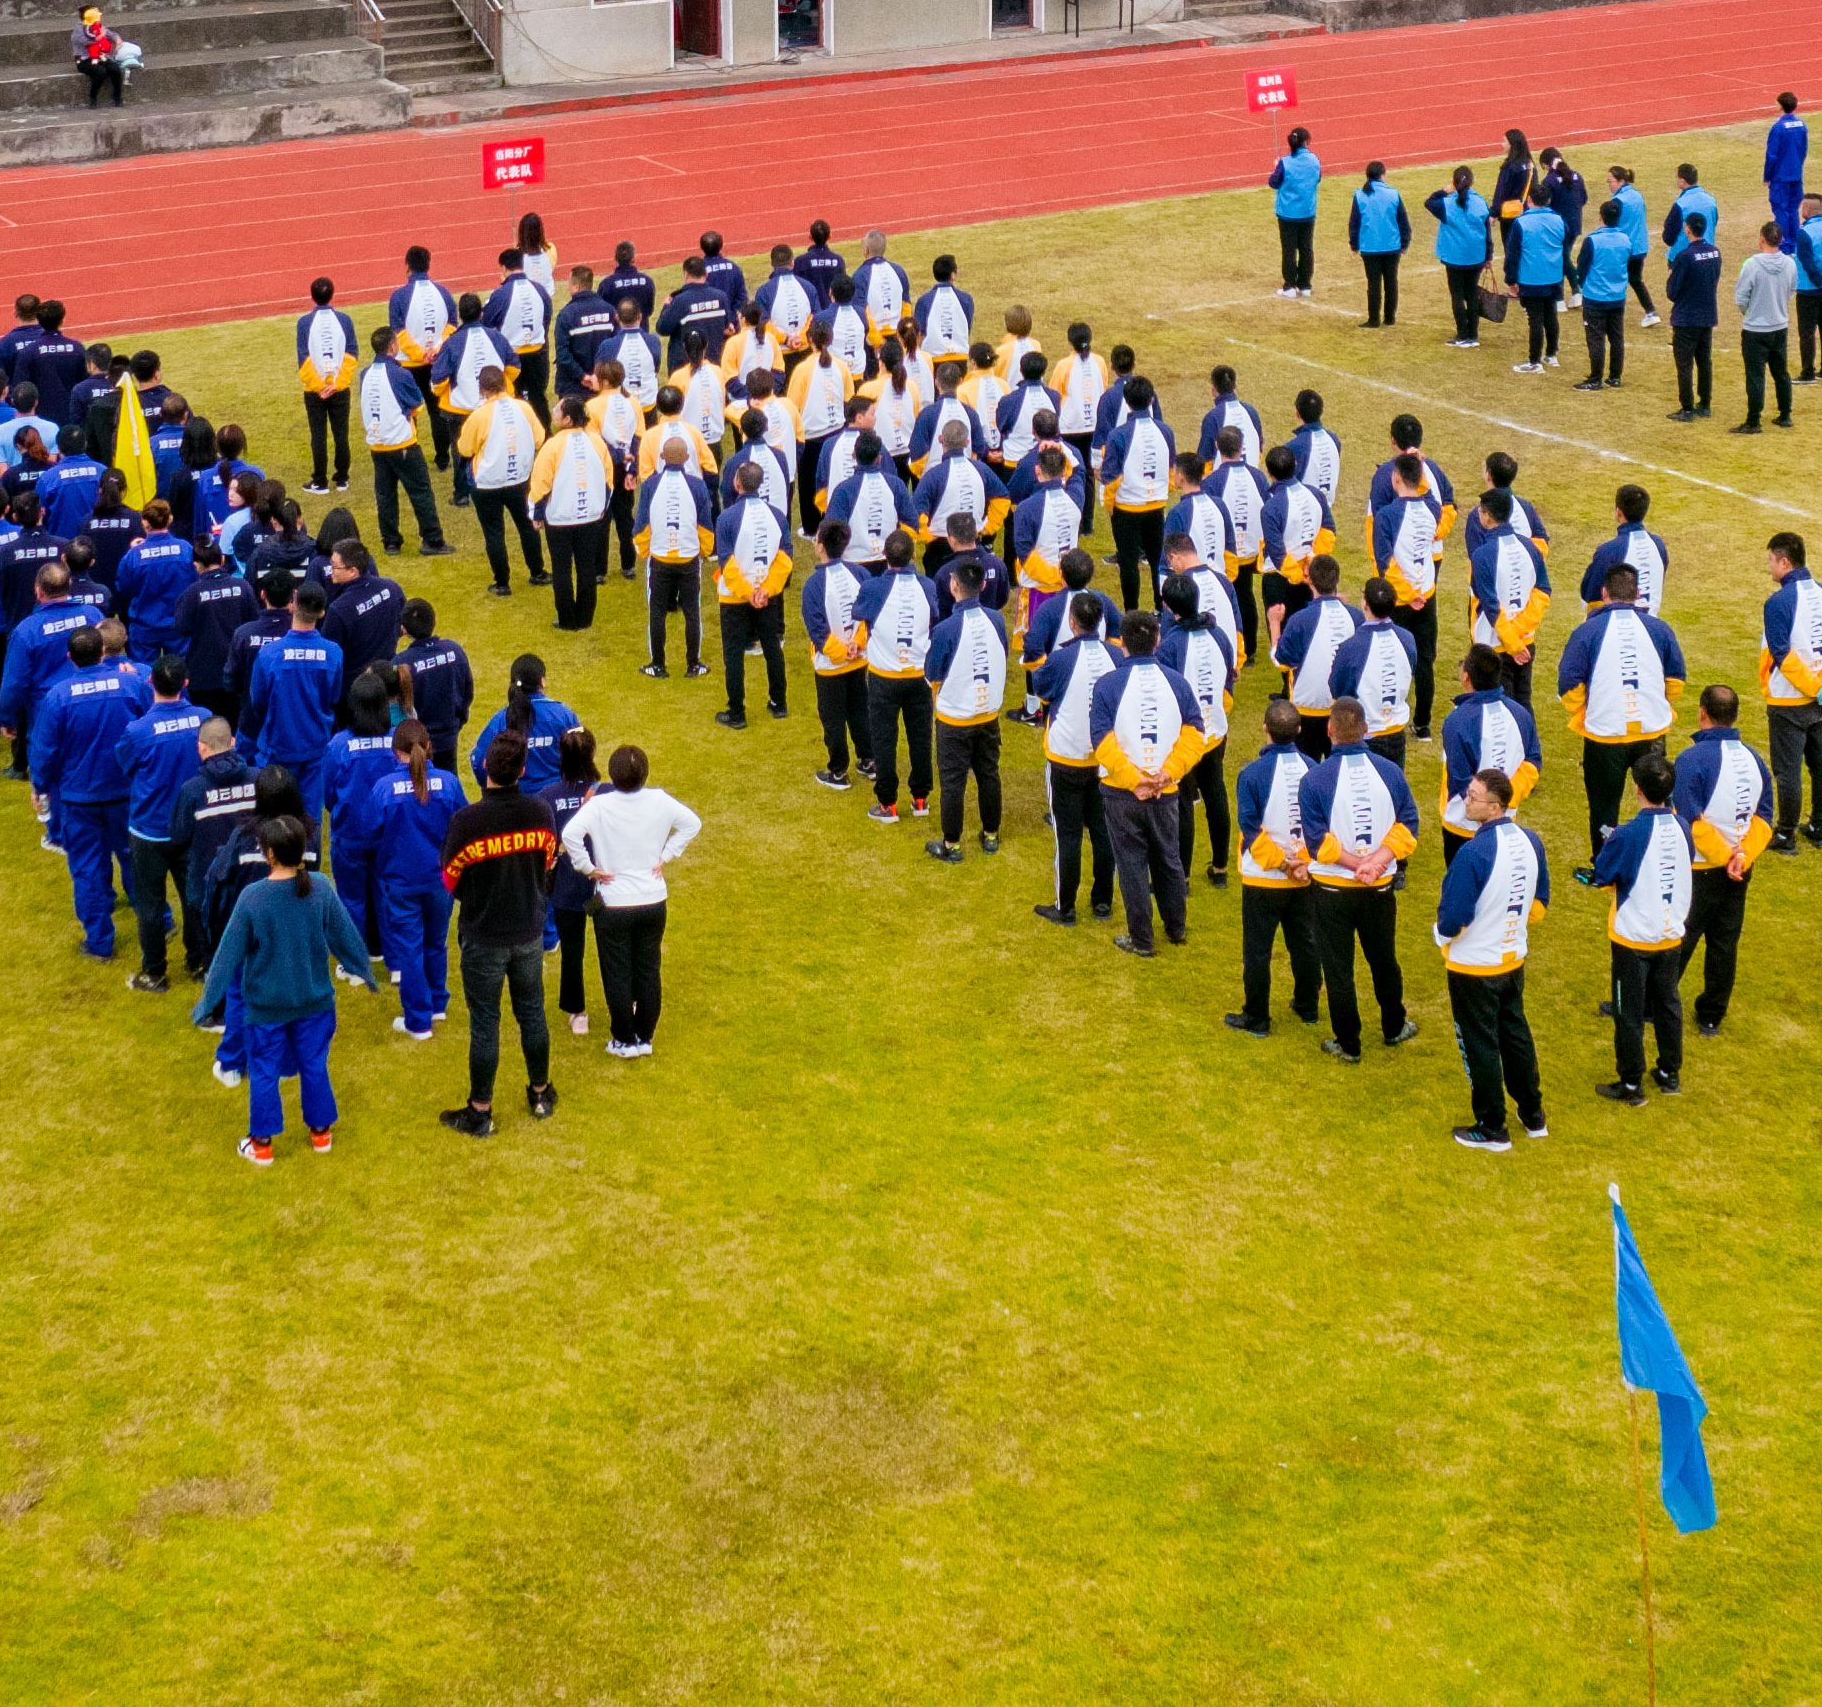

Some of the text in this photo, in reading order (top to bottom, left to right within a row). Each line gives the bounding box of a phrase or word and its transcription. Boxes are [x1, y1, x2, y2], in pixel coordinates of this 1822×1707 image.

[1258, 90, 1287, 105] 代表队
[495, 163, 533, 181] 代表队
[1617, 620, 1639, 678] MOVING
[70, 677, 121, 697] 凌云集团
[1138, 670, 1158, 731] MOVING
[205, 783, 256, 804] 凌云集团
[1349, 766, 1372, 833] MOVING
